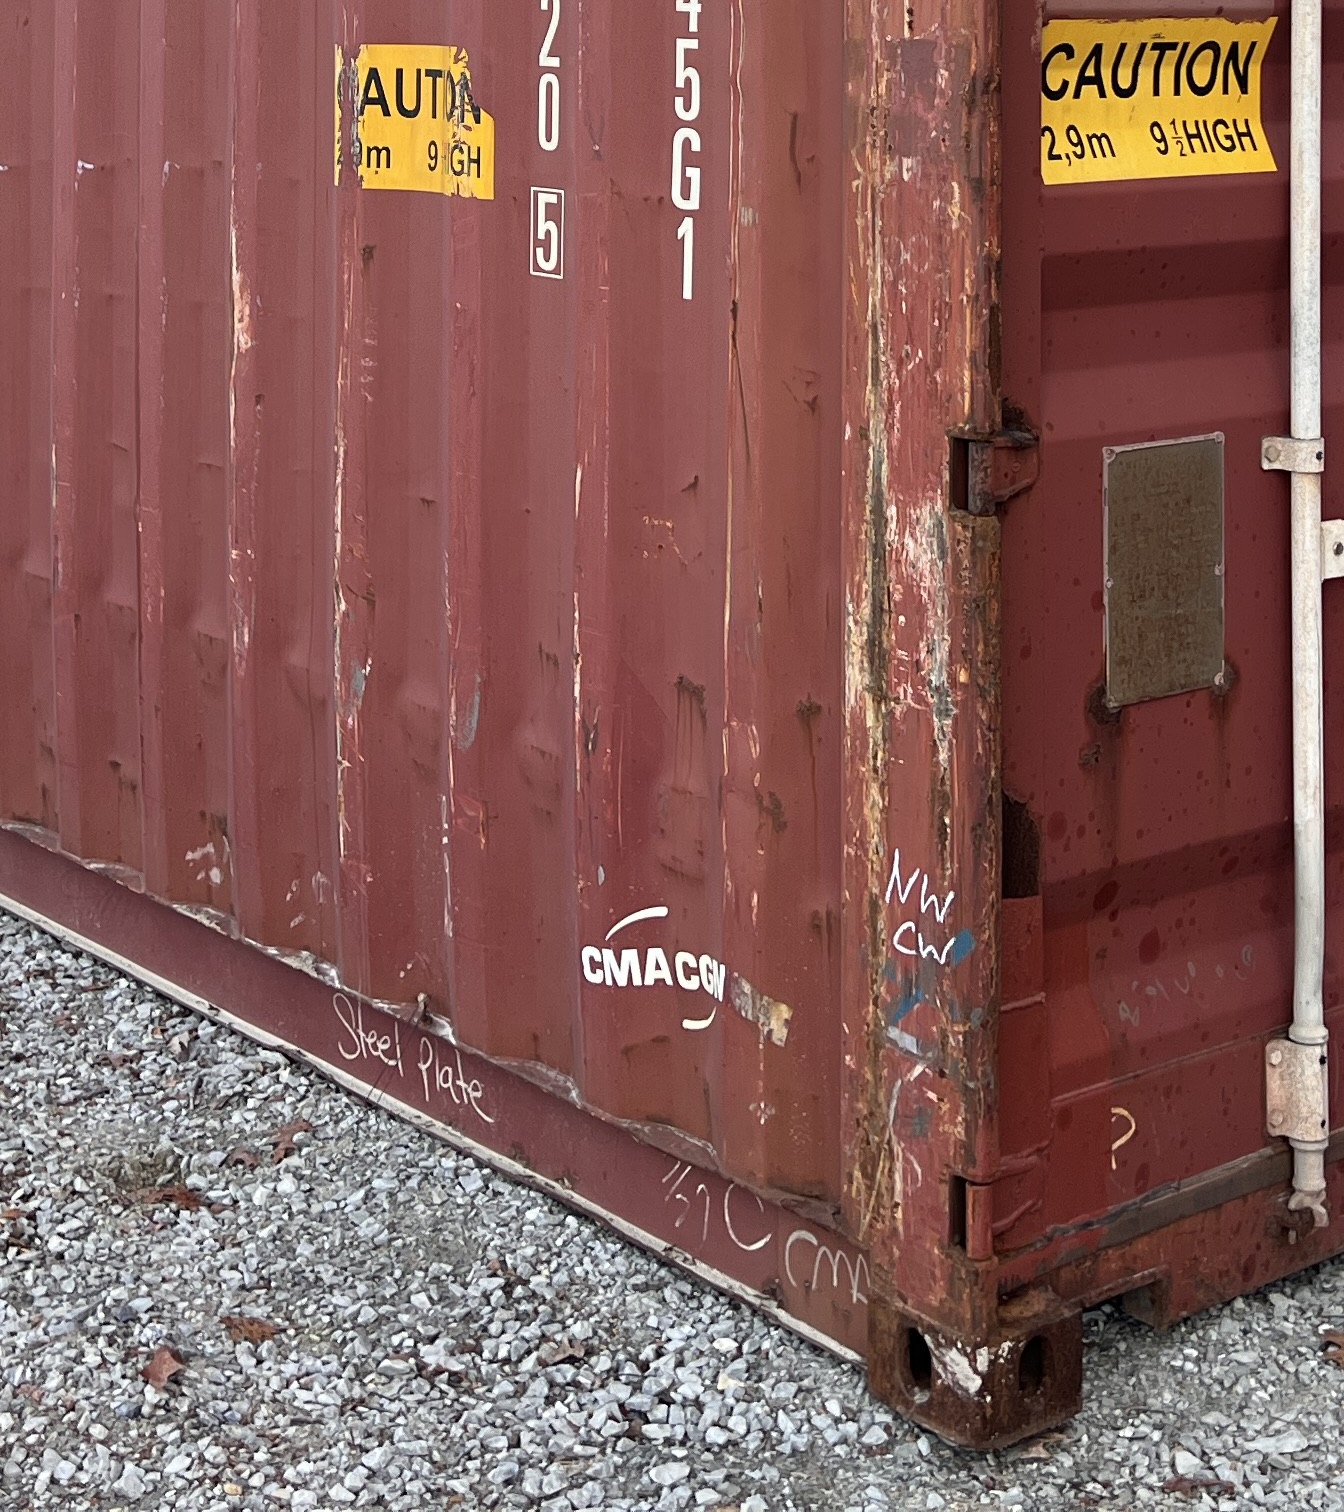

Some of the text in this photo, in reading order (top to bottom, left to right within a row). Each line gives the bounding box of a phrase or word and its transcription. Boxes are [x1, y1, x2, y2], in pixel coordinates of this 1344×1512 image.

[1042, 41, 1258, 101] CAUTION
[536, 192, 558, 272] 5
[581, 945, 673, 987] CMA
[333, 993, 404, 1077] Steel
[418, 1037, 495, 1123] Plate
